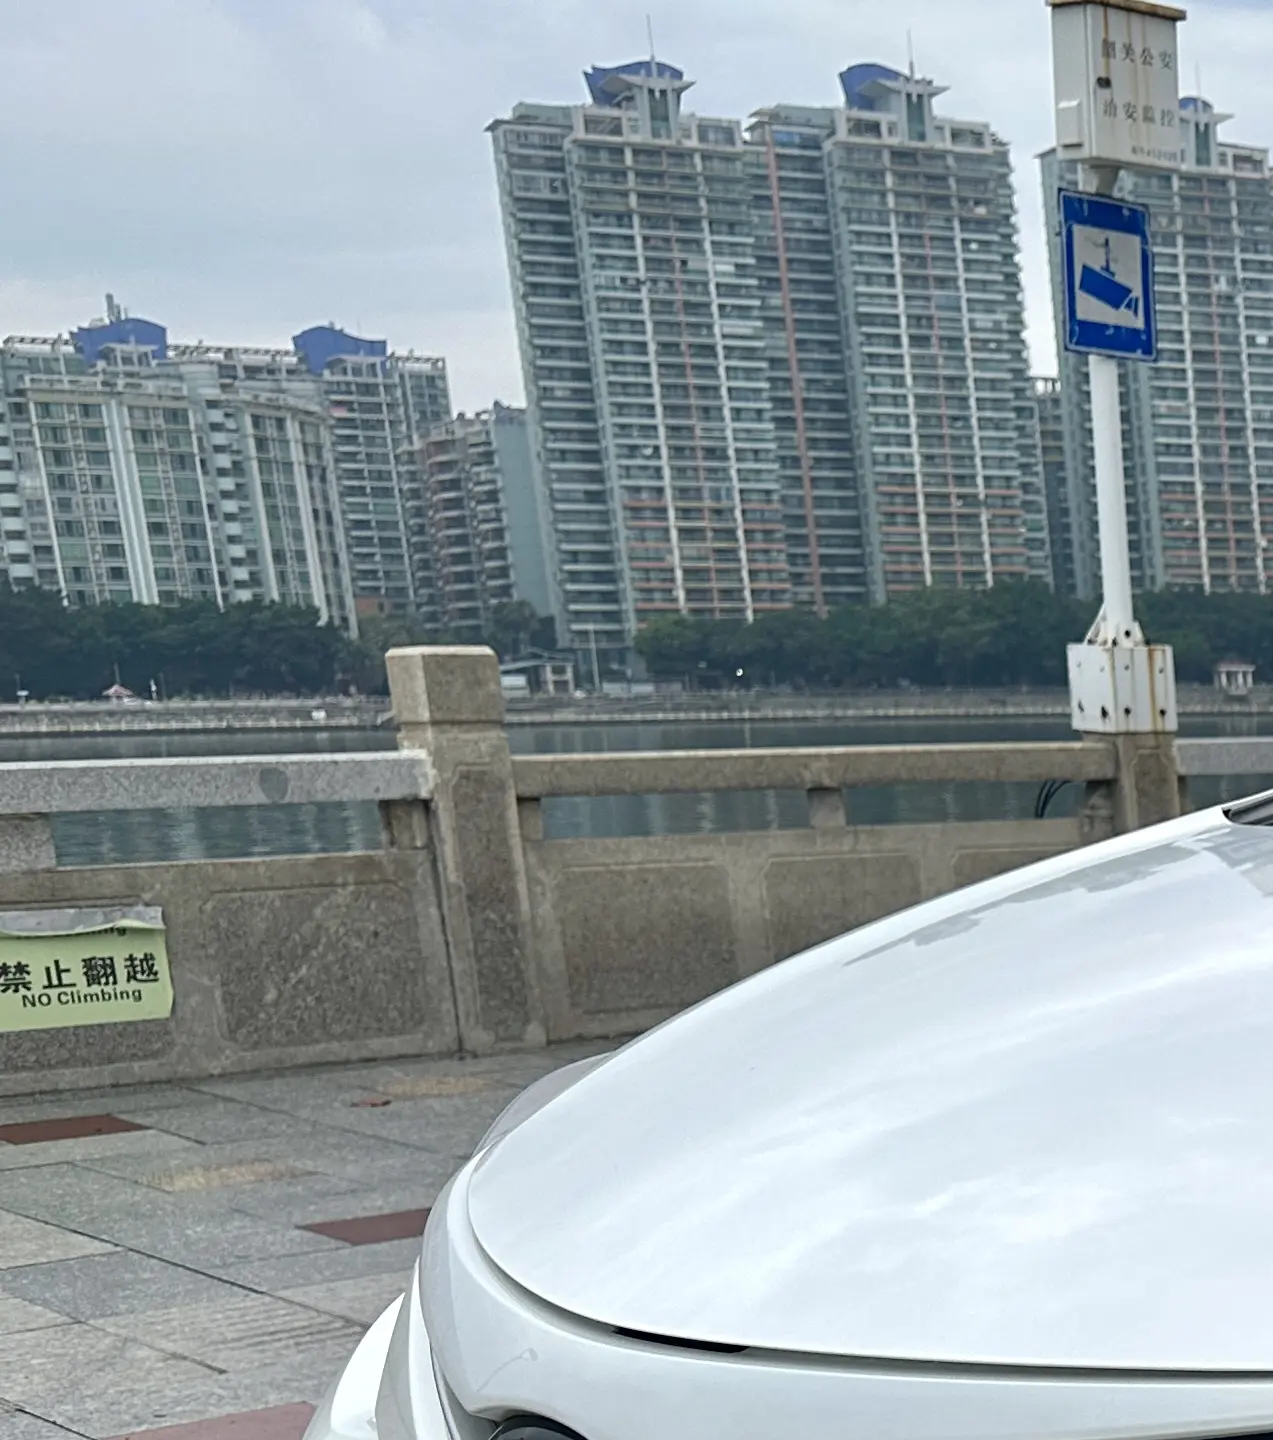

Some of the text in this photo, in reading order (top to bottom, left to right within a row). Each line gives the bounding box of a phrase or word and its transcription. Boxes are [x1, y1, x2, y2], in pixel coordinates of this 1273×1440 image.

[0, 952, 160, 993] 禁止翻越
[22, 988, 142, 1008] NO Climbing
